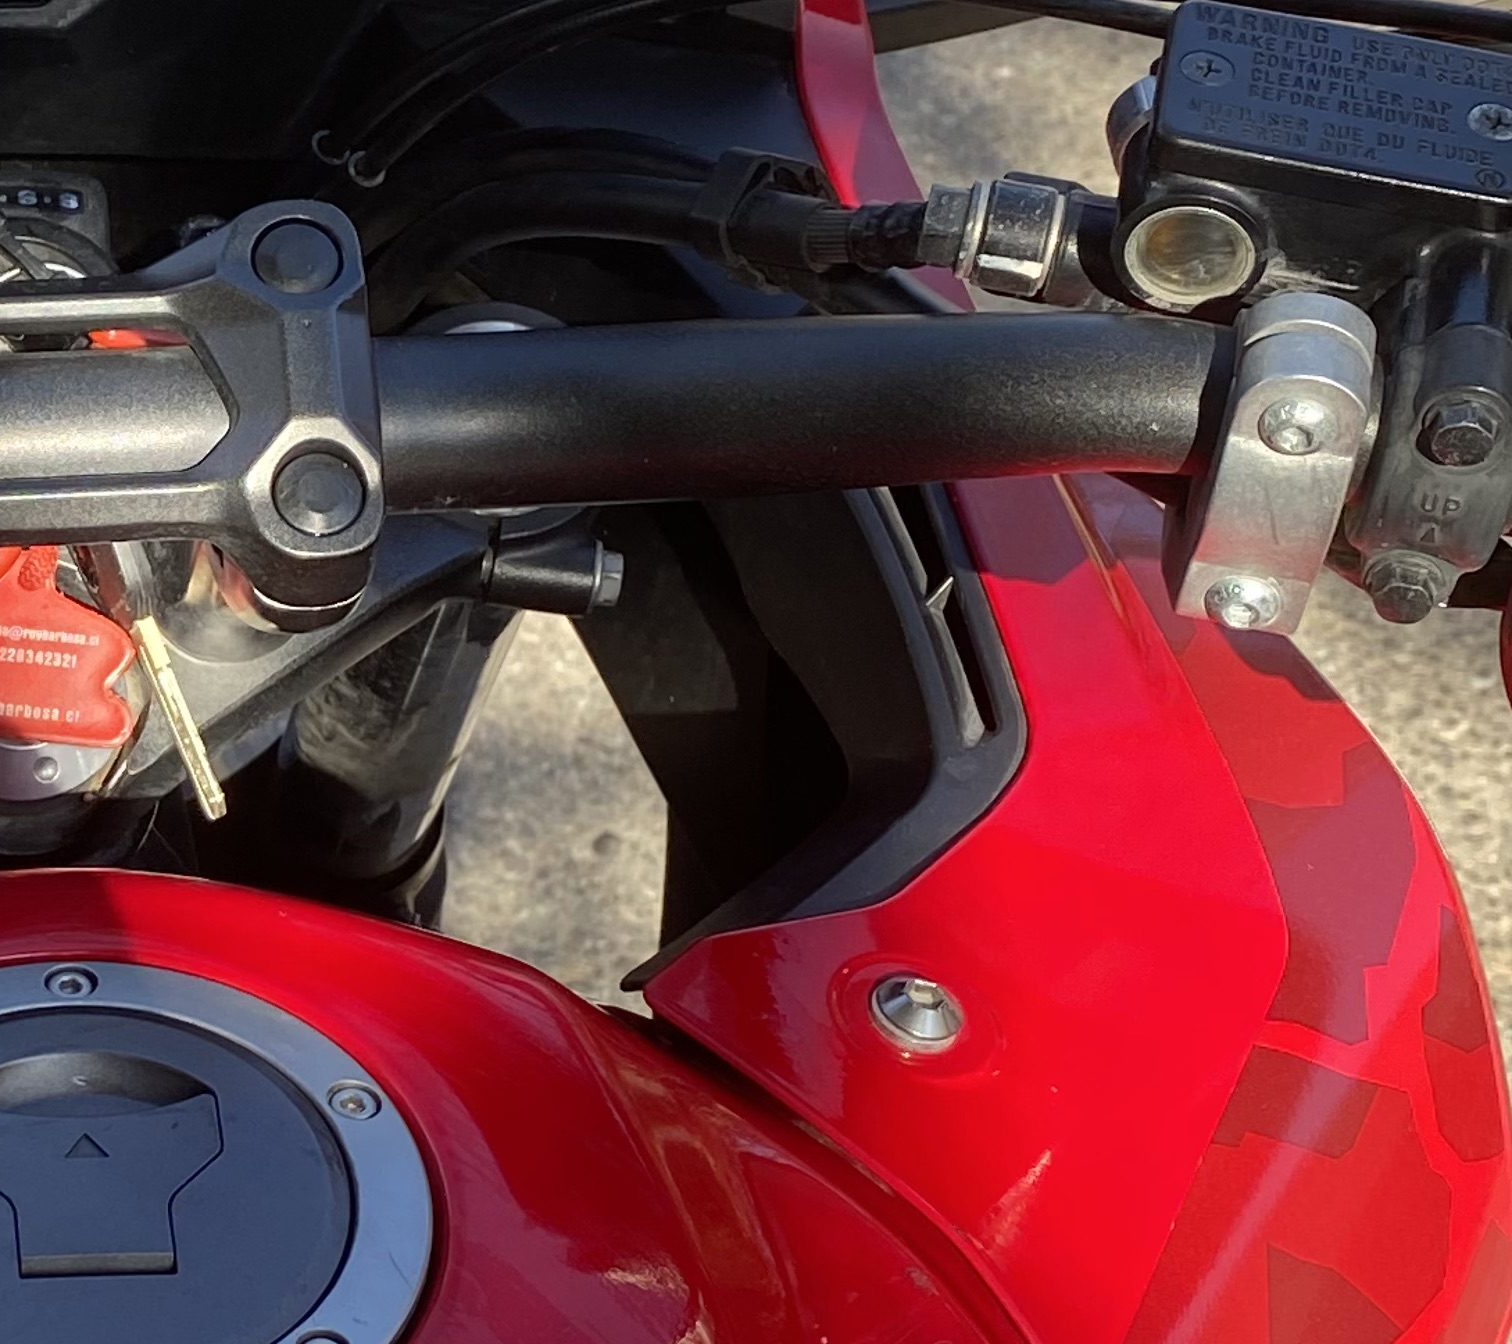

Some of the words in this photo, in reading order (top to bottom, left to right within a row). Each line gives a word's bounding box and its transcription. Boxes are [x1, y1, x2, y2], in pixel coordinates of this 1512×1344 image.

[1196, 5, 1330, 44] WARNING
[1352, 36, 1394, 55] USE
[1208, 26, 1278, 52] BRAKE
[1284, 40, 1343, 64] FLUID
[1351, 53, 1407, 75] FROM
[1414, 64, 1428, 80] A
[1248, 84, 1331, 113] BEFORE
[1251, 68, 1321, 93] CLEAN
[1329, 82, 1403, 107] FILLER
[1412, 96, 1453, 116] CAP
[1241, 123, 1308, 148] FREIN
[1323, 122, 1365, 144] QUE
[1376, 131, 1406, 151] DU
[1417, 138, 1494, 167] FLUIDE
[1419, 492, 1462, 516] UP
